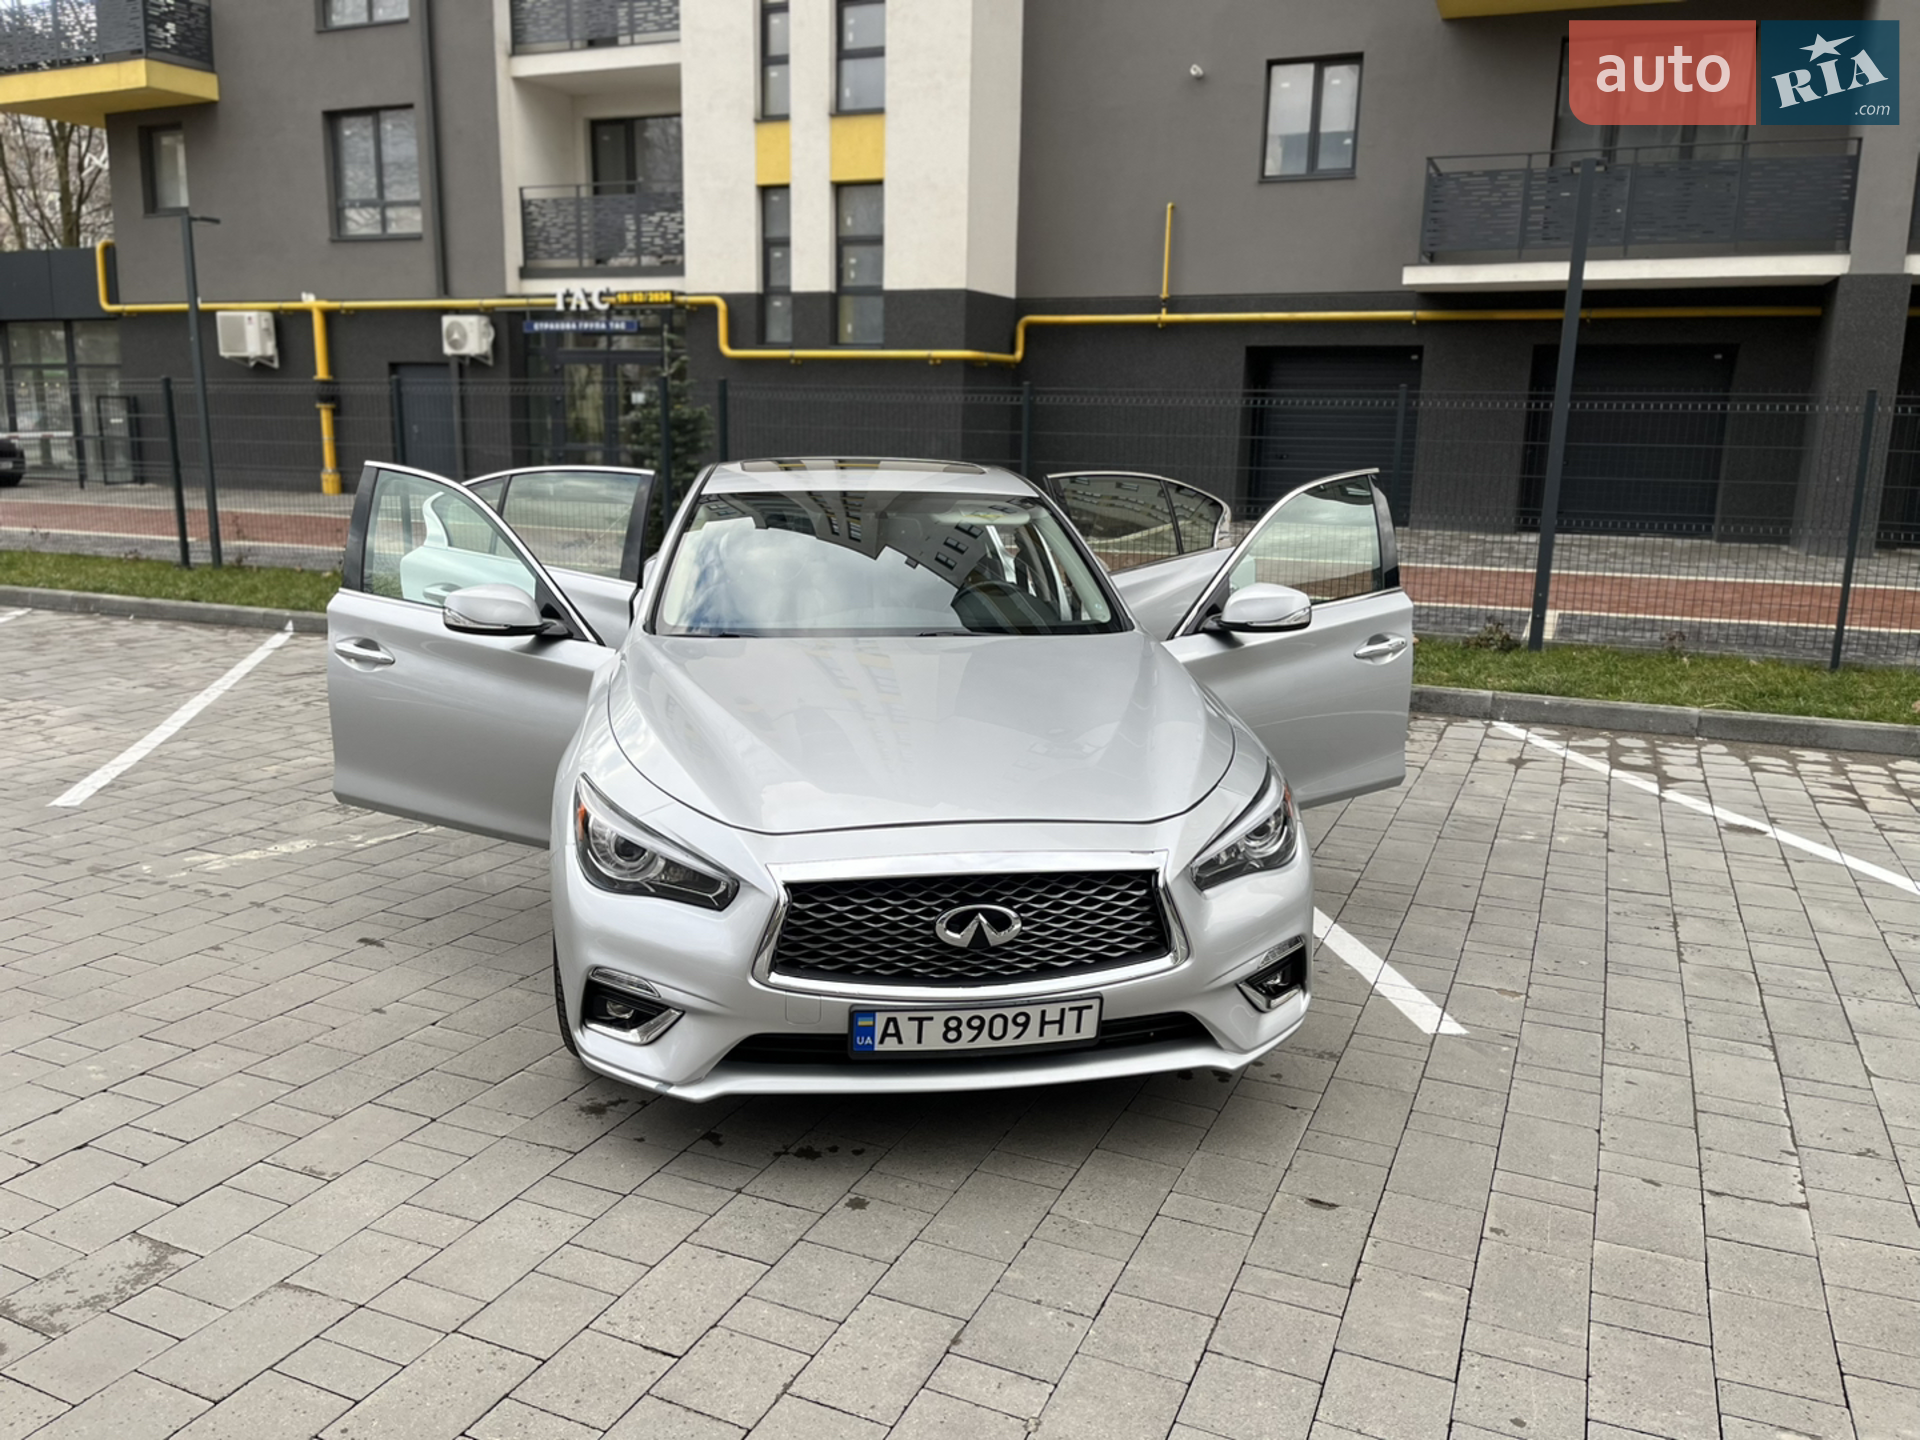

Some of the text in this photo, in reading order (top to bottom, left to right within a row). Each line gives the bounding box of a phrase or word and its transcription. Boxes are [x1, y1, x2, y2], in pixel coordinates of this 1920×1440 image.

[554, 287, 611, 311] ТАС
[878, 1004, 1094, 1045] AT 8909 HT
[856, 1036, 873, 1046] UA
